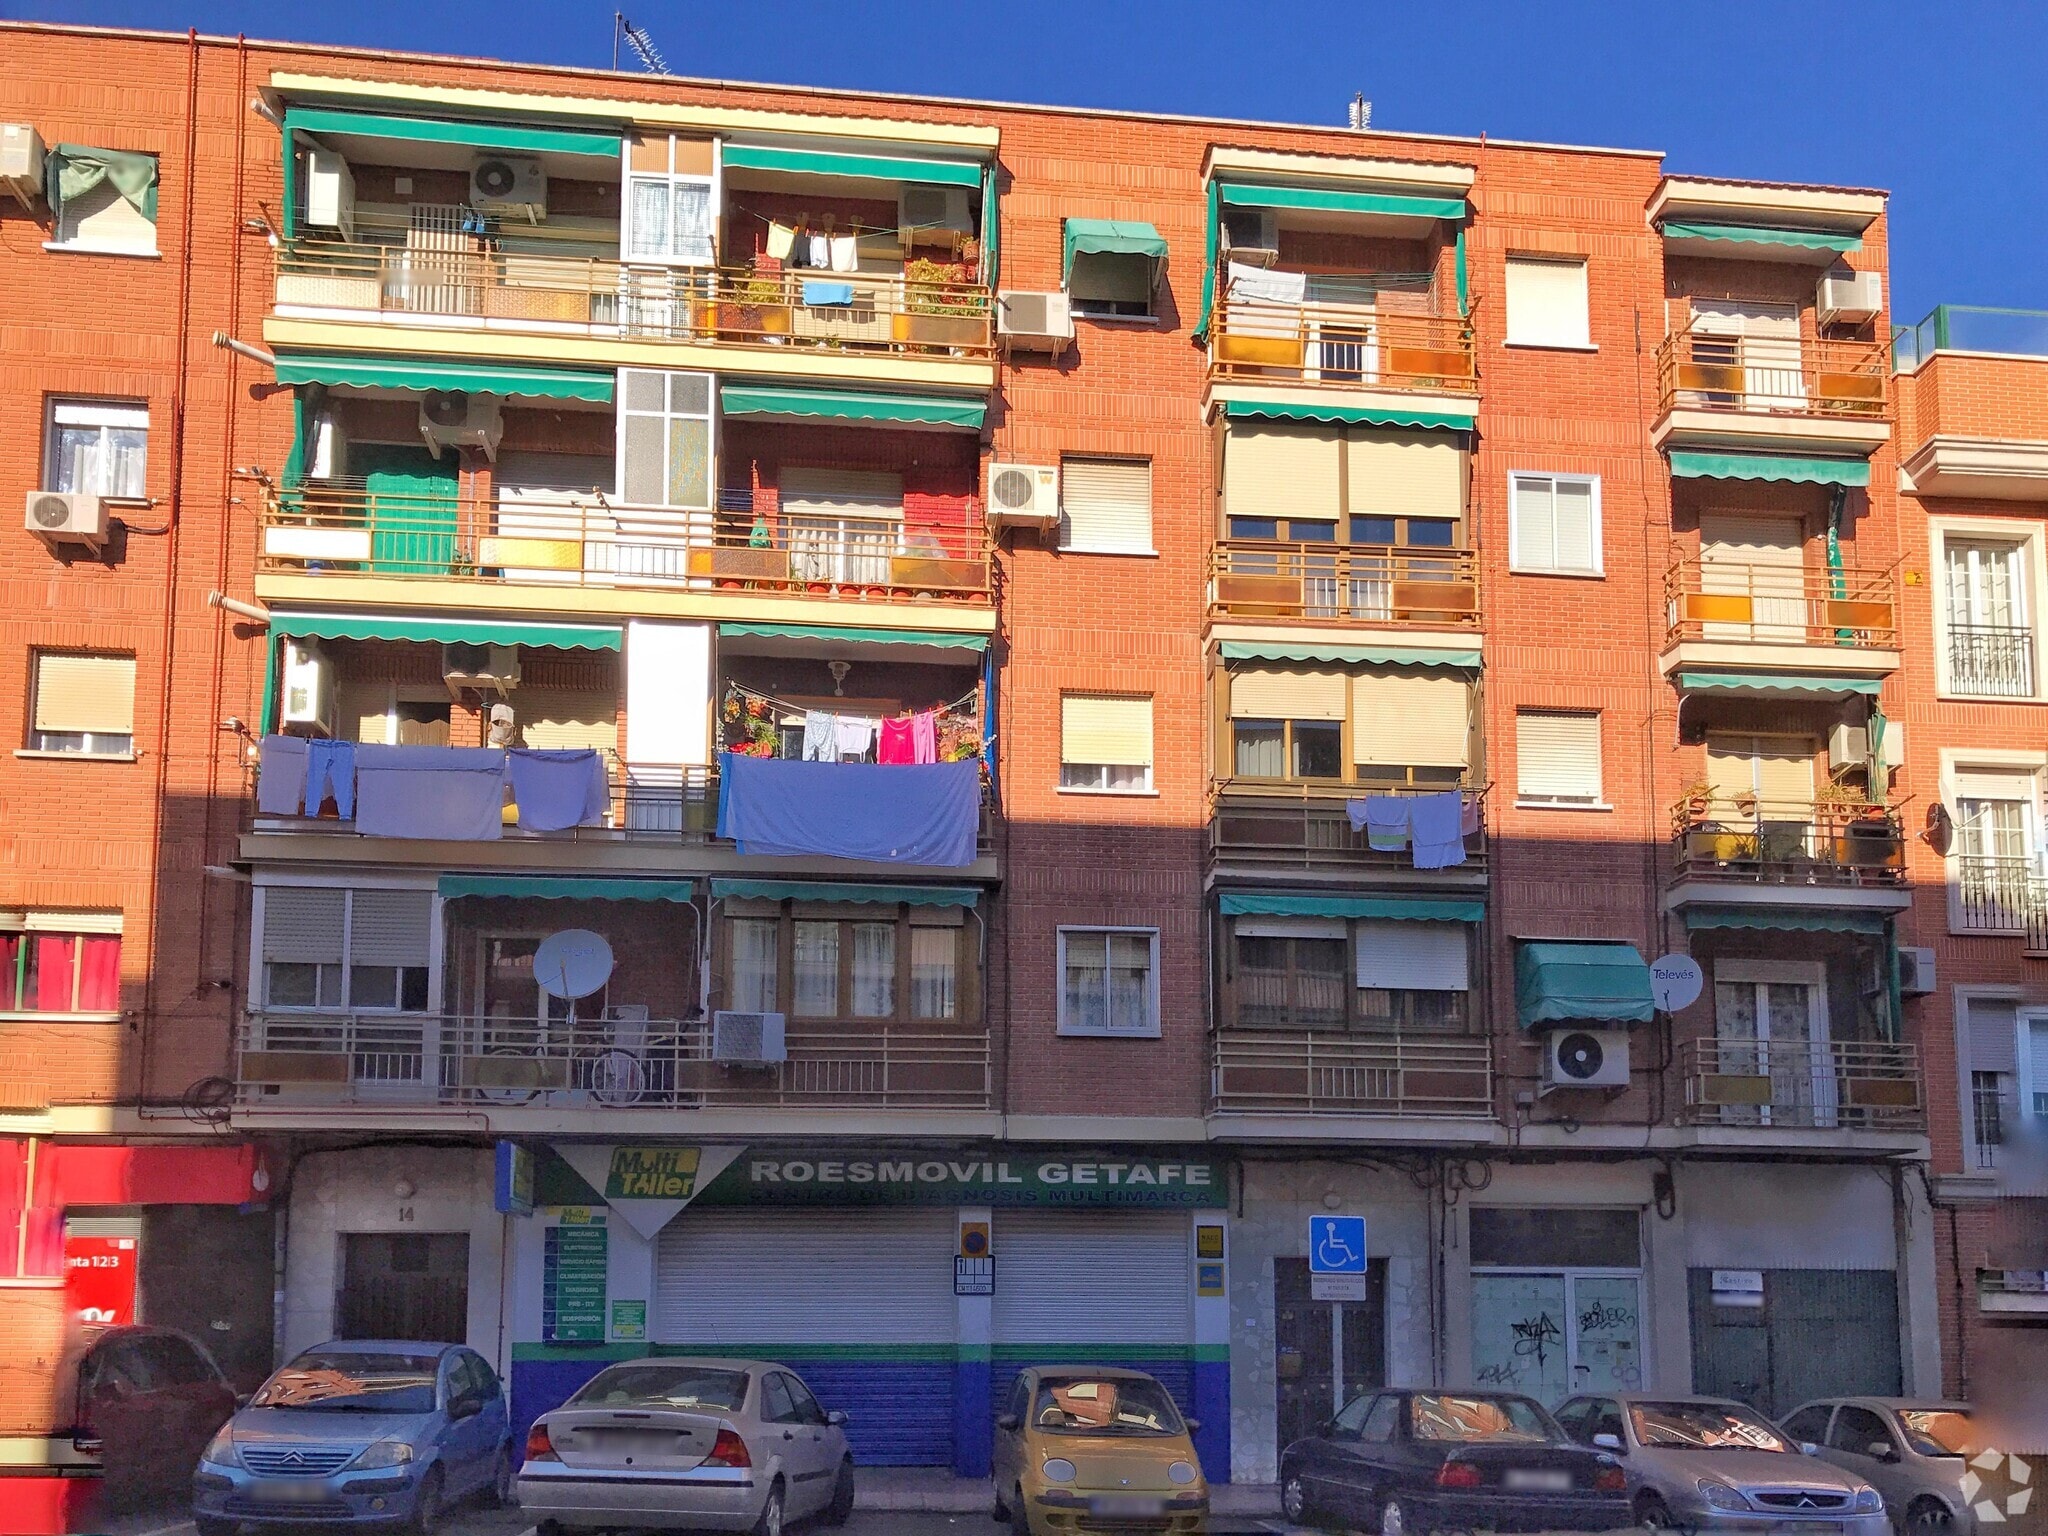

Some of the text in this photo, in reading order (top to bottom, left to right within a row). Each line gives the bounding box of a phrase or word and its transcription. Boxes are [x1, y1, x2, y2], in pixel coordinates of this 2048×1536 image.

[1653, 968, 1694, 980] Televés
[615, 1151, 679, 1173] Multi
[751, 1161, 1211, 1185] ROESMOVIL GETAFE
[622, 1172, 694, 1196] Taller
[902, 1188, 1038, 1202] DIAGNOSIS
[1048, 1190, 1211, 1203] MULTIMARCA
[399, 1207, 414, 1222] 14
[559, 1271, 606, 1279] CLIMATIZACIÓN
